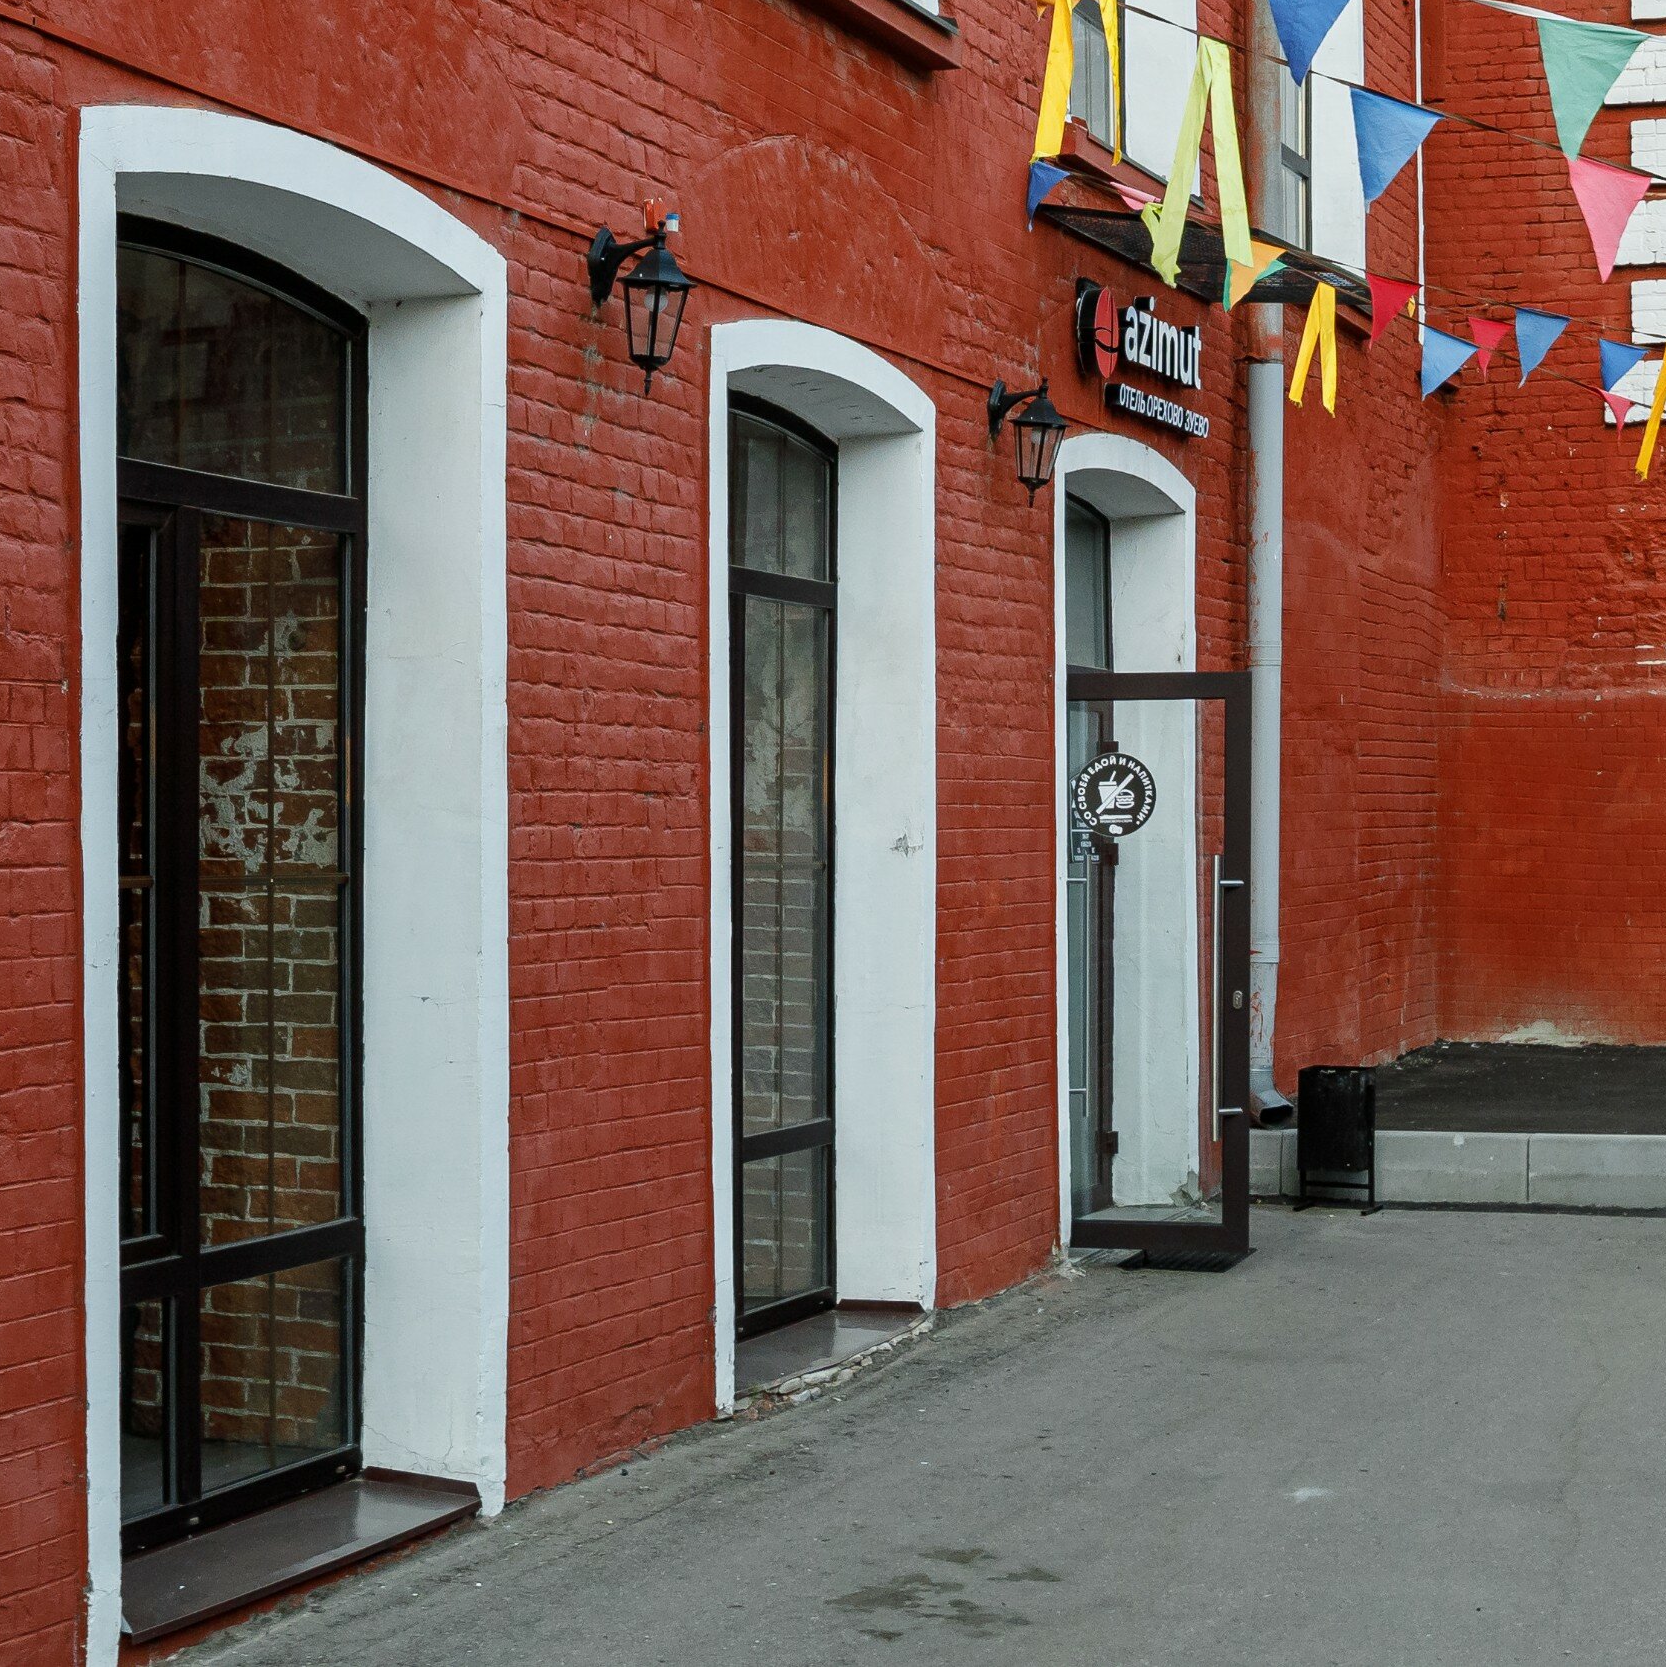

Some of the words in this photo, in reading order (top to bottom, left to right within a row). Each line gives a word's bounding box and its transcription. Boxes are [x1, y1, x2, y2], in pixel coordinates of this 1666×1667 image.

[1125, 296, 1201, 390] azimut
[1119, 383, 1146, 414] ОТЕЛЬ
[1146, 394, 1184, 428] ОРЕХОВО
[1184, 409, 1209, 438] ЗУЕВО
[1077, 773, 1091, 810] СВОЕЙ
[1118, 756, 1127, 766] И
[1127, 760, 1153, 822] НАПИТКАМИ
